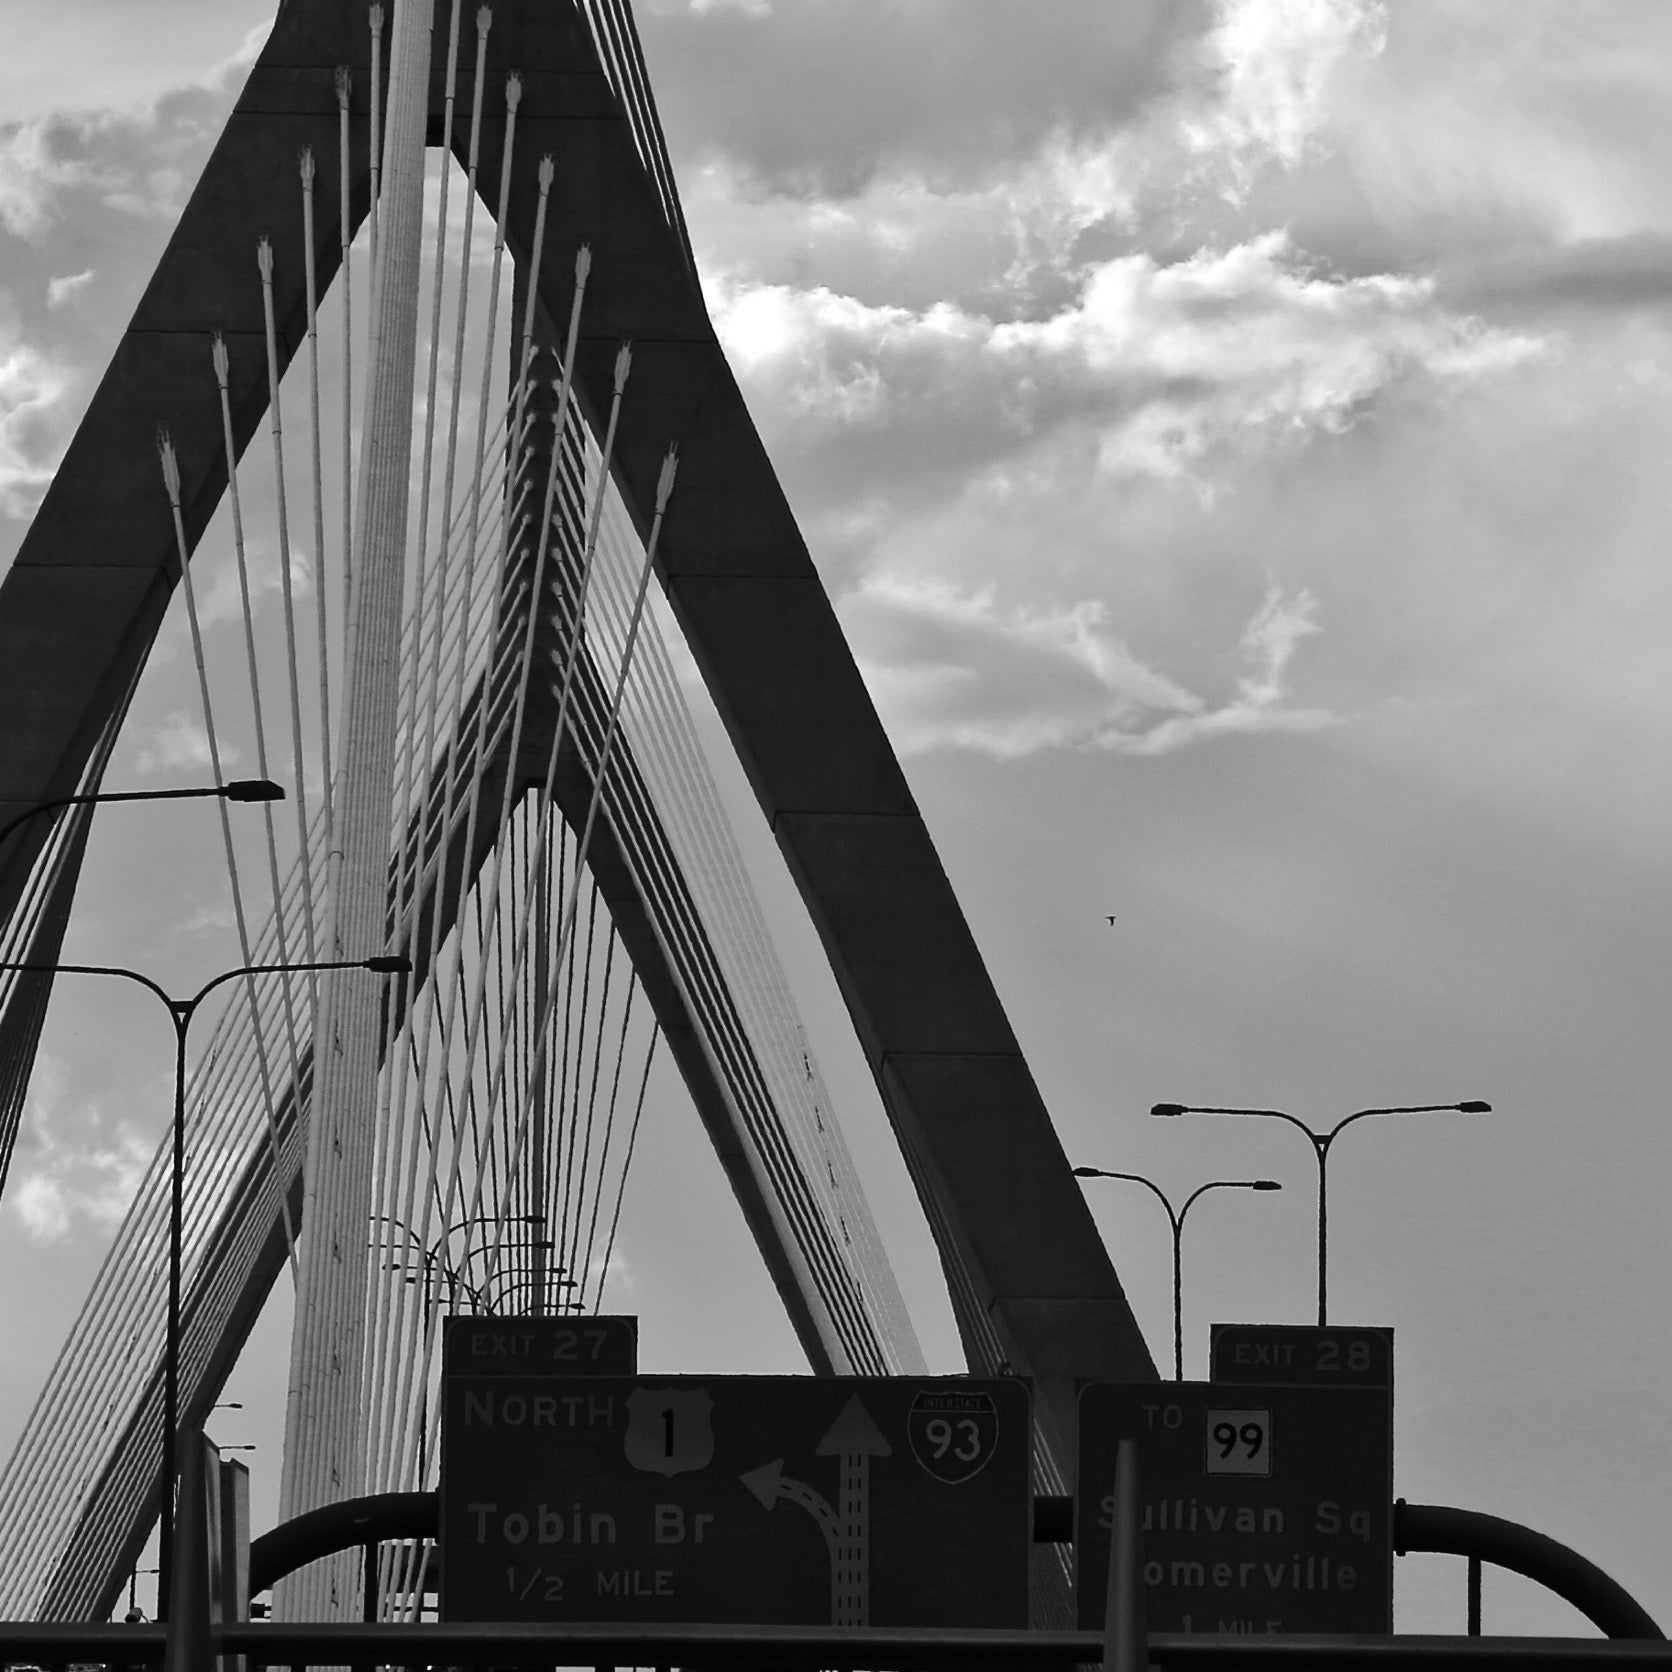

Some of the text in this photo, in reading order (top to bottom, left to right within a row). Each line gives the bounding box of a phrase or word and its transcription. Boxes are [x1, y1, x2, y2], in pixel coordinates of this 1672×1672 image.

[471, 1329, 608, 1361] EXIT 27
[1234, 1340, 1370, 1372] EXIT 28
[923, 1397, 984, 1410] INTERSTATE
[464, 1390, 676, 1459] NORTH 1
[926, 1419, 981, 1461] 93
[1142, 1404, 1263, 1460] TO 99
[467, 1502, 715, 1545] Tobin Br
[1314, 1500, 1370, 1544] Sq
[507, 1566, 675, 1602] 1/2 MILE
[1142, 1553, 1359, 1590] omerville
